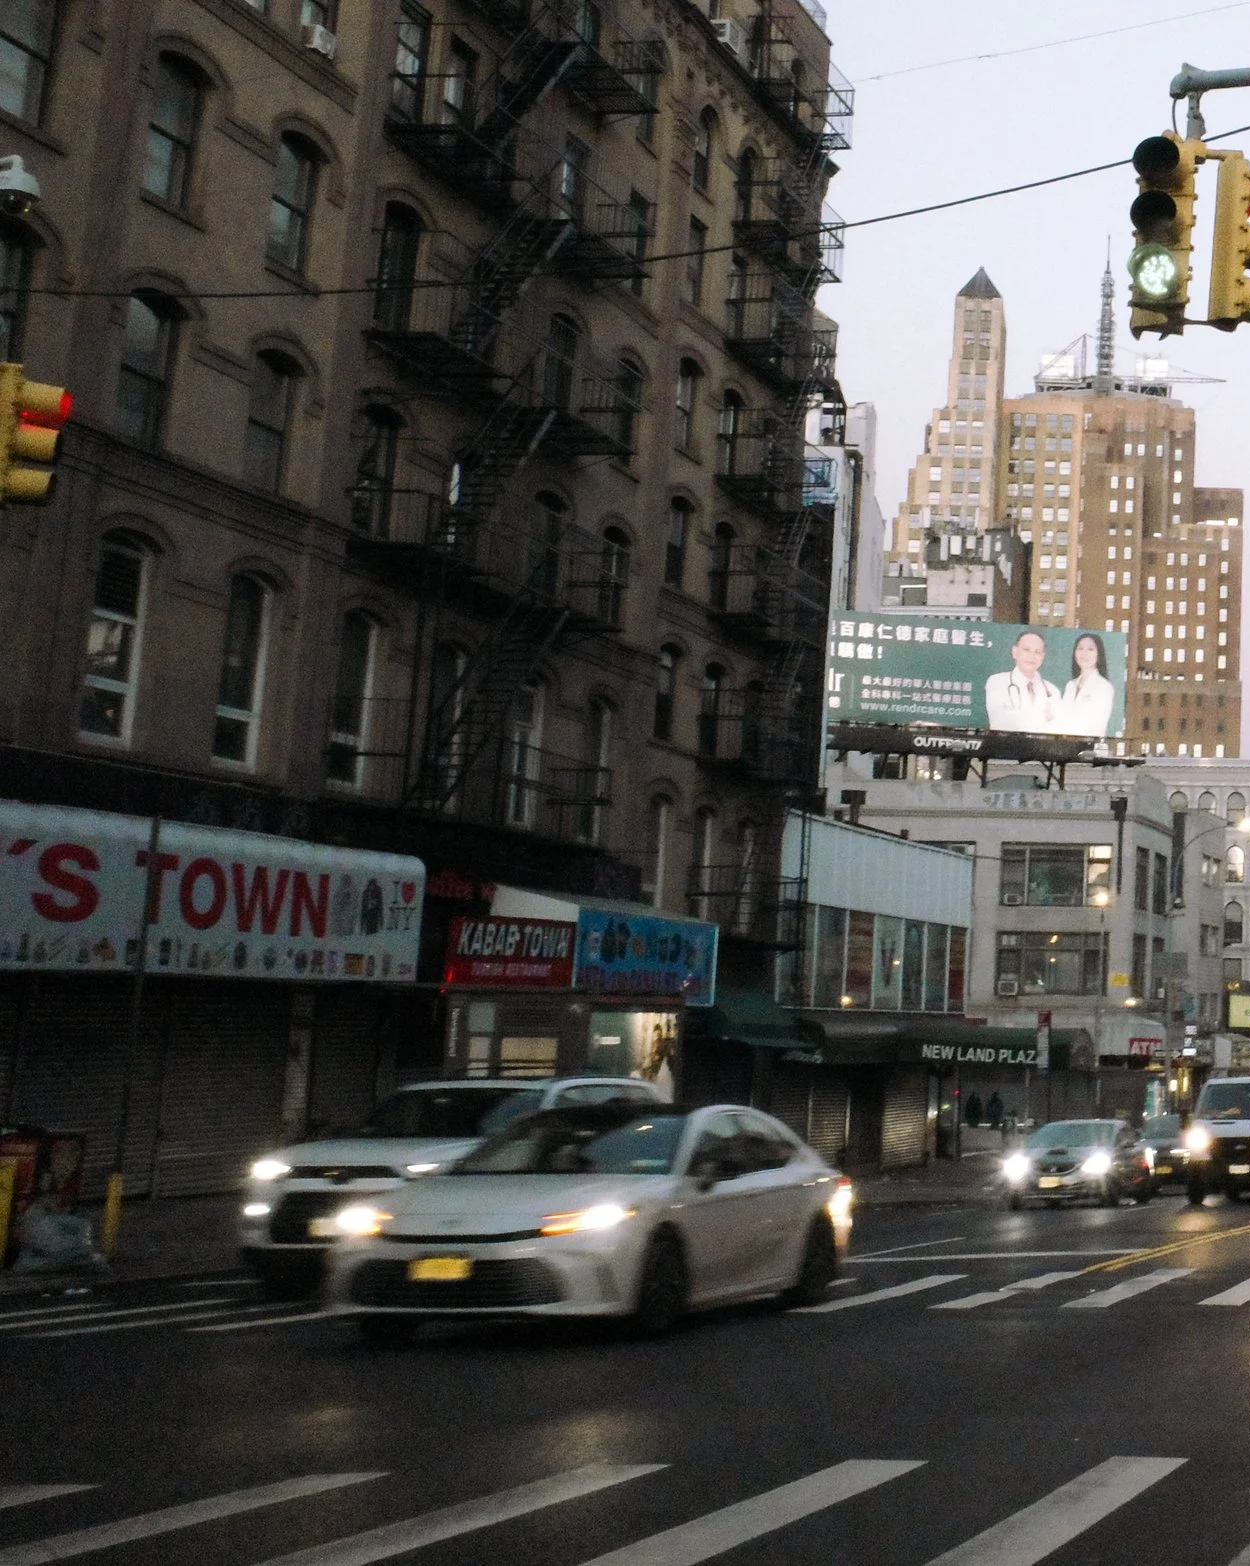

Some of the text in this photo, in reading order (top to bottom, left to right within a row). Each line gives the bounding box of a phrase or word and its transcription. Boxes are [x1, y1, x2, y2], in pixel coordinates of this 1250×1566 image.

[860, 702, 972, 717] www.rendrcare.com
[7, 839, 331, 939] 'S TOWN
[456, 921, 521, 956] KABAB
[922, 1044, 1037, 1065] NEW LAND PLAZ
